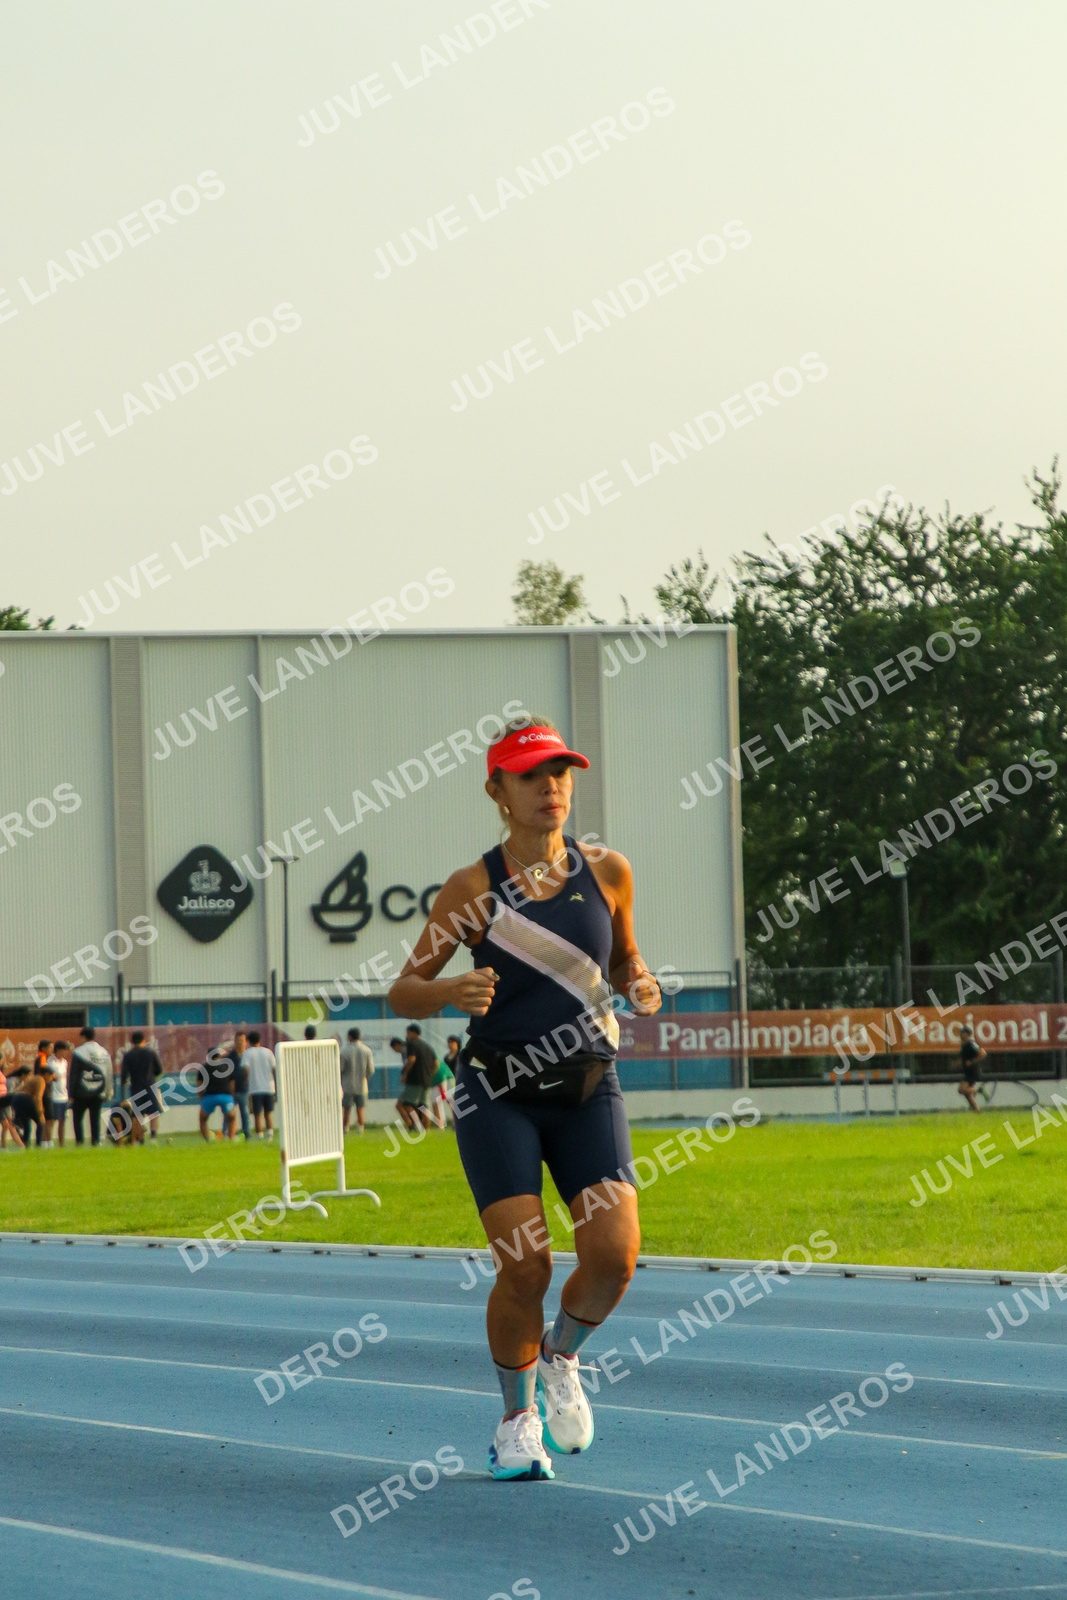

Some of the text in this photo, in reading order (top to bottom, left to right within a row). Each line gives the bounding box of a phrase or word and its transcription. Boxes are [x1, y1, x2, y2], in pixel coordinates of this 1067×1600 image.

[177, 896, 236, 911] Jalisco
[658, 1015, 868, 1055] Paralimpiada
[903, 1011, 1049, 1045] Nacional
